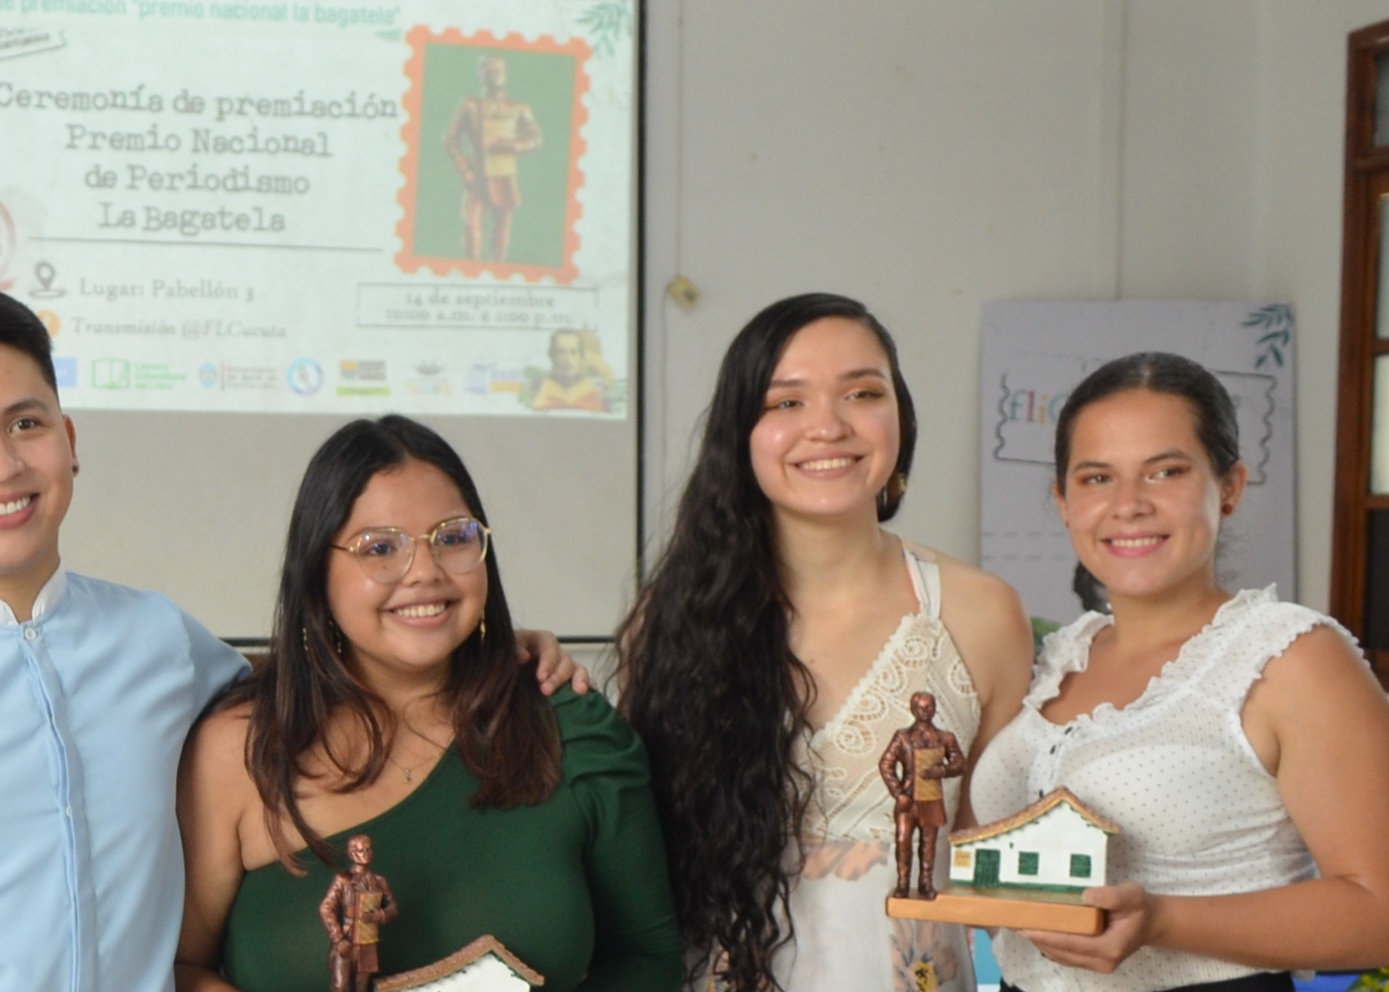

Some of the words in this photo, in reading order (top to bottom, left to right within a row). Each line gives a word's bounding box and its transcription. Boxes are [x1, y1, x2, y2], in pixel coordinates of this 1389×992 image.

[293, 2, 310, 22] la
[172, 89, 205, 114] de
[215, 89, 398, 122] premiación
[65, 123, 182, 152] Premio
[191, 126, 333, 157] Nacional
[84, 164, 118, 189] de
[126, 163, 310, 195] Periodismo
[98, 202, 136, 229] La
[142, 205, 287, 236] Bagatela
[79, 277, 145, 301] Lugar:
[152, 277, 239, 299] Pabellón
[429, 286, 450, 305] de
[455, 287, 555, 309] septiembre
